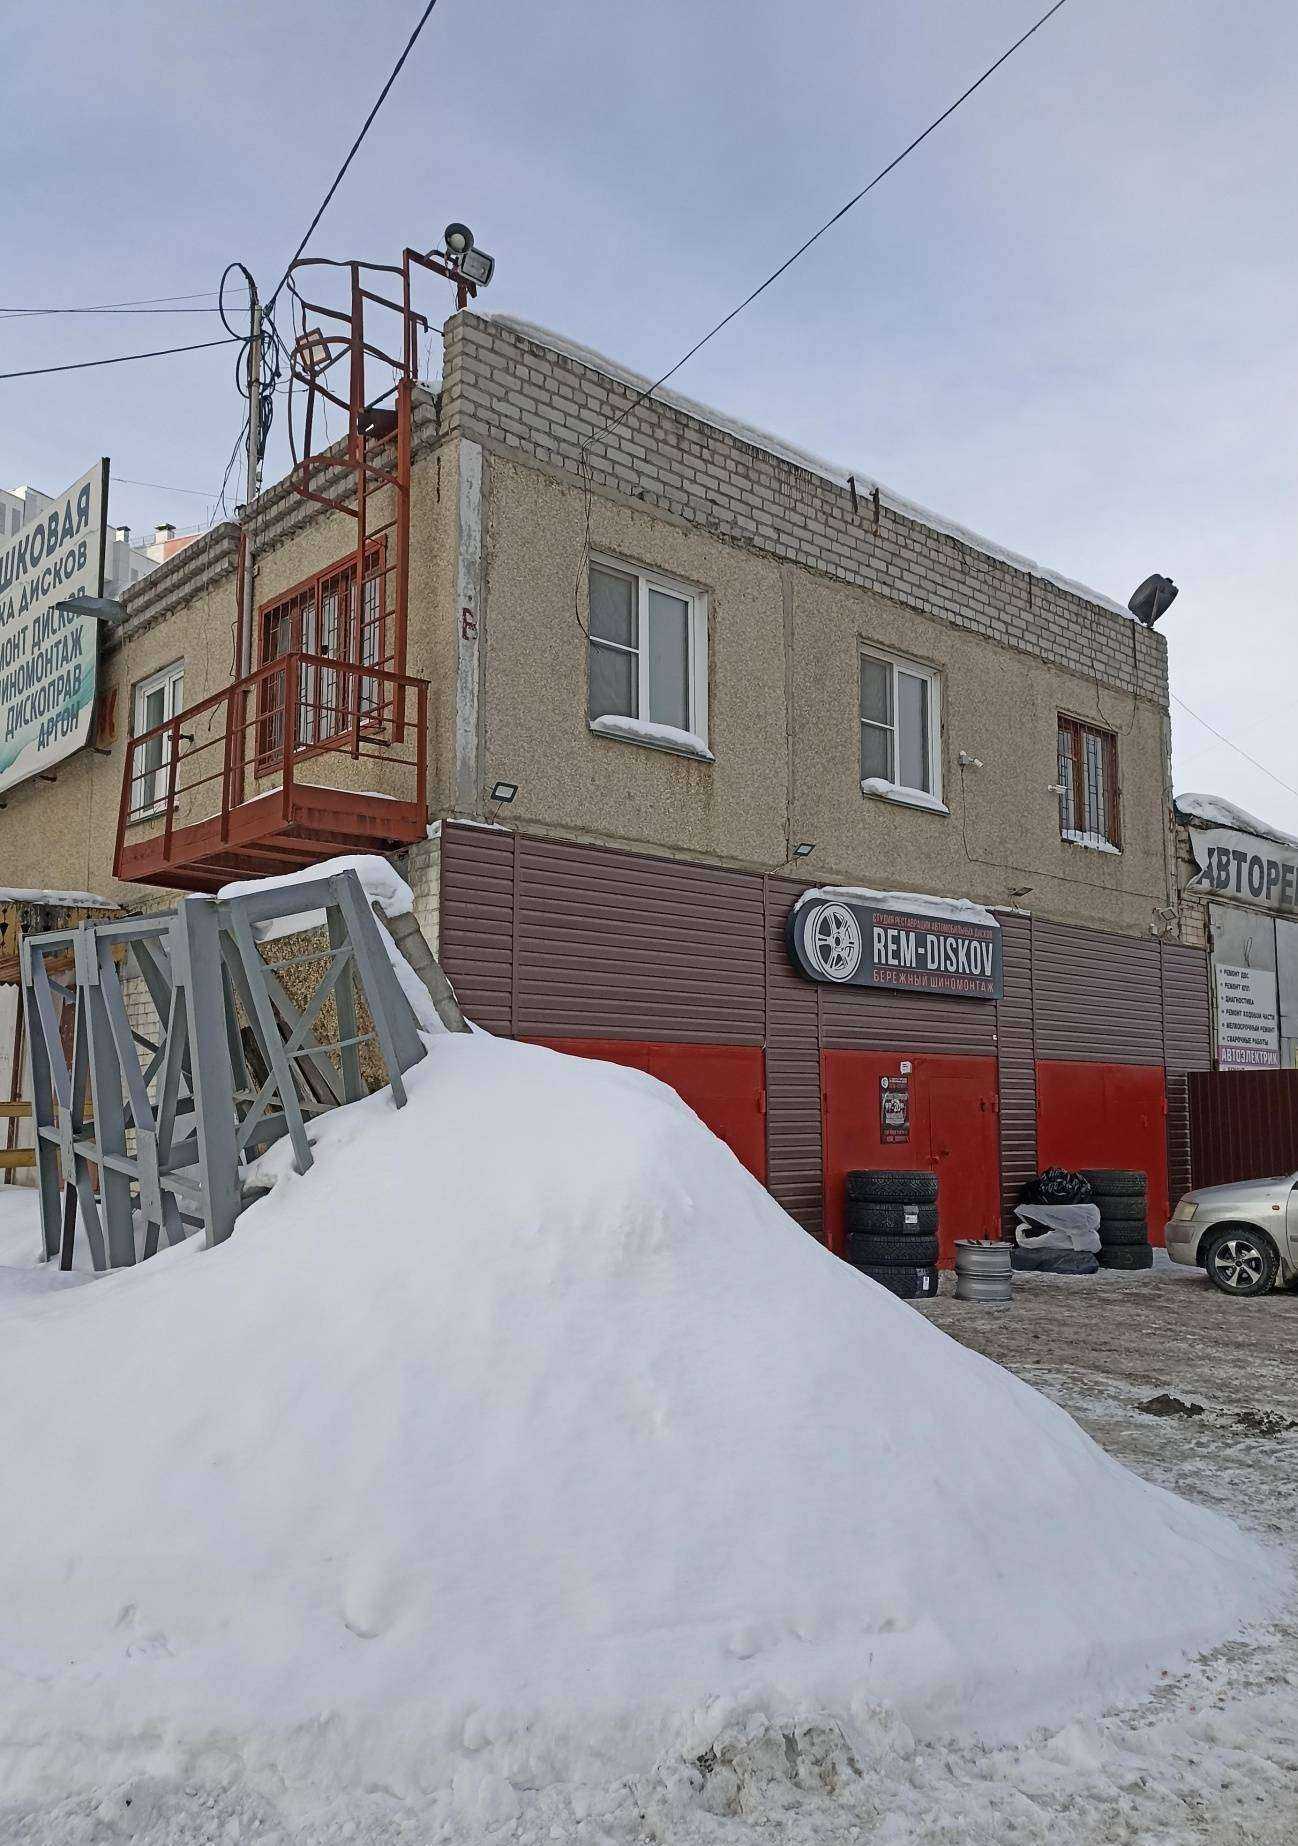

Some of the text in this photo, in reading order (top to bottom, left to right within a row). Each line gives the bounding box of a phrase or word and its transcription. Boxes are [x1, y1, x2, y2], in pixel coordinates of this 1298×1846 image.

[18, 540, 87, 617] ДИСКОВ
[0, 624, 84, 706] ИНОМОНТАЖ
[5, 663, 82, 742] ДИСКОПРАВ
[37, 701, 80, 751] АРГОН
[1195, 846, 1298, 907] АВТОРЕ
[873, 926, 993, 976] REM-DISKOV
[873, 969, 994, 993] БЕРЕЖНЫЙ ШИНОМОНТАЖ
[1221, 1048, 1279, 1065] АВТОЭЛЕКТРИК
